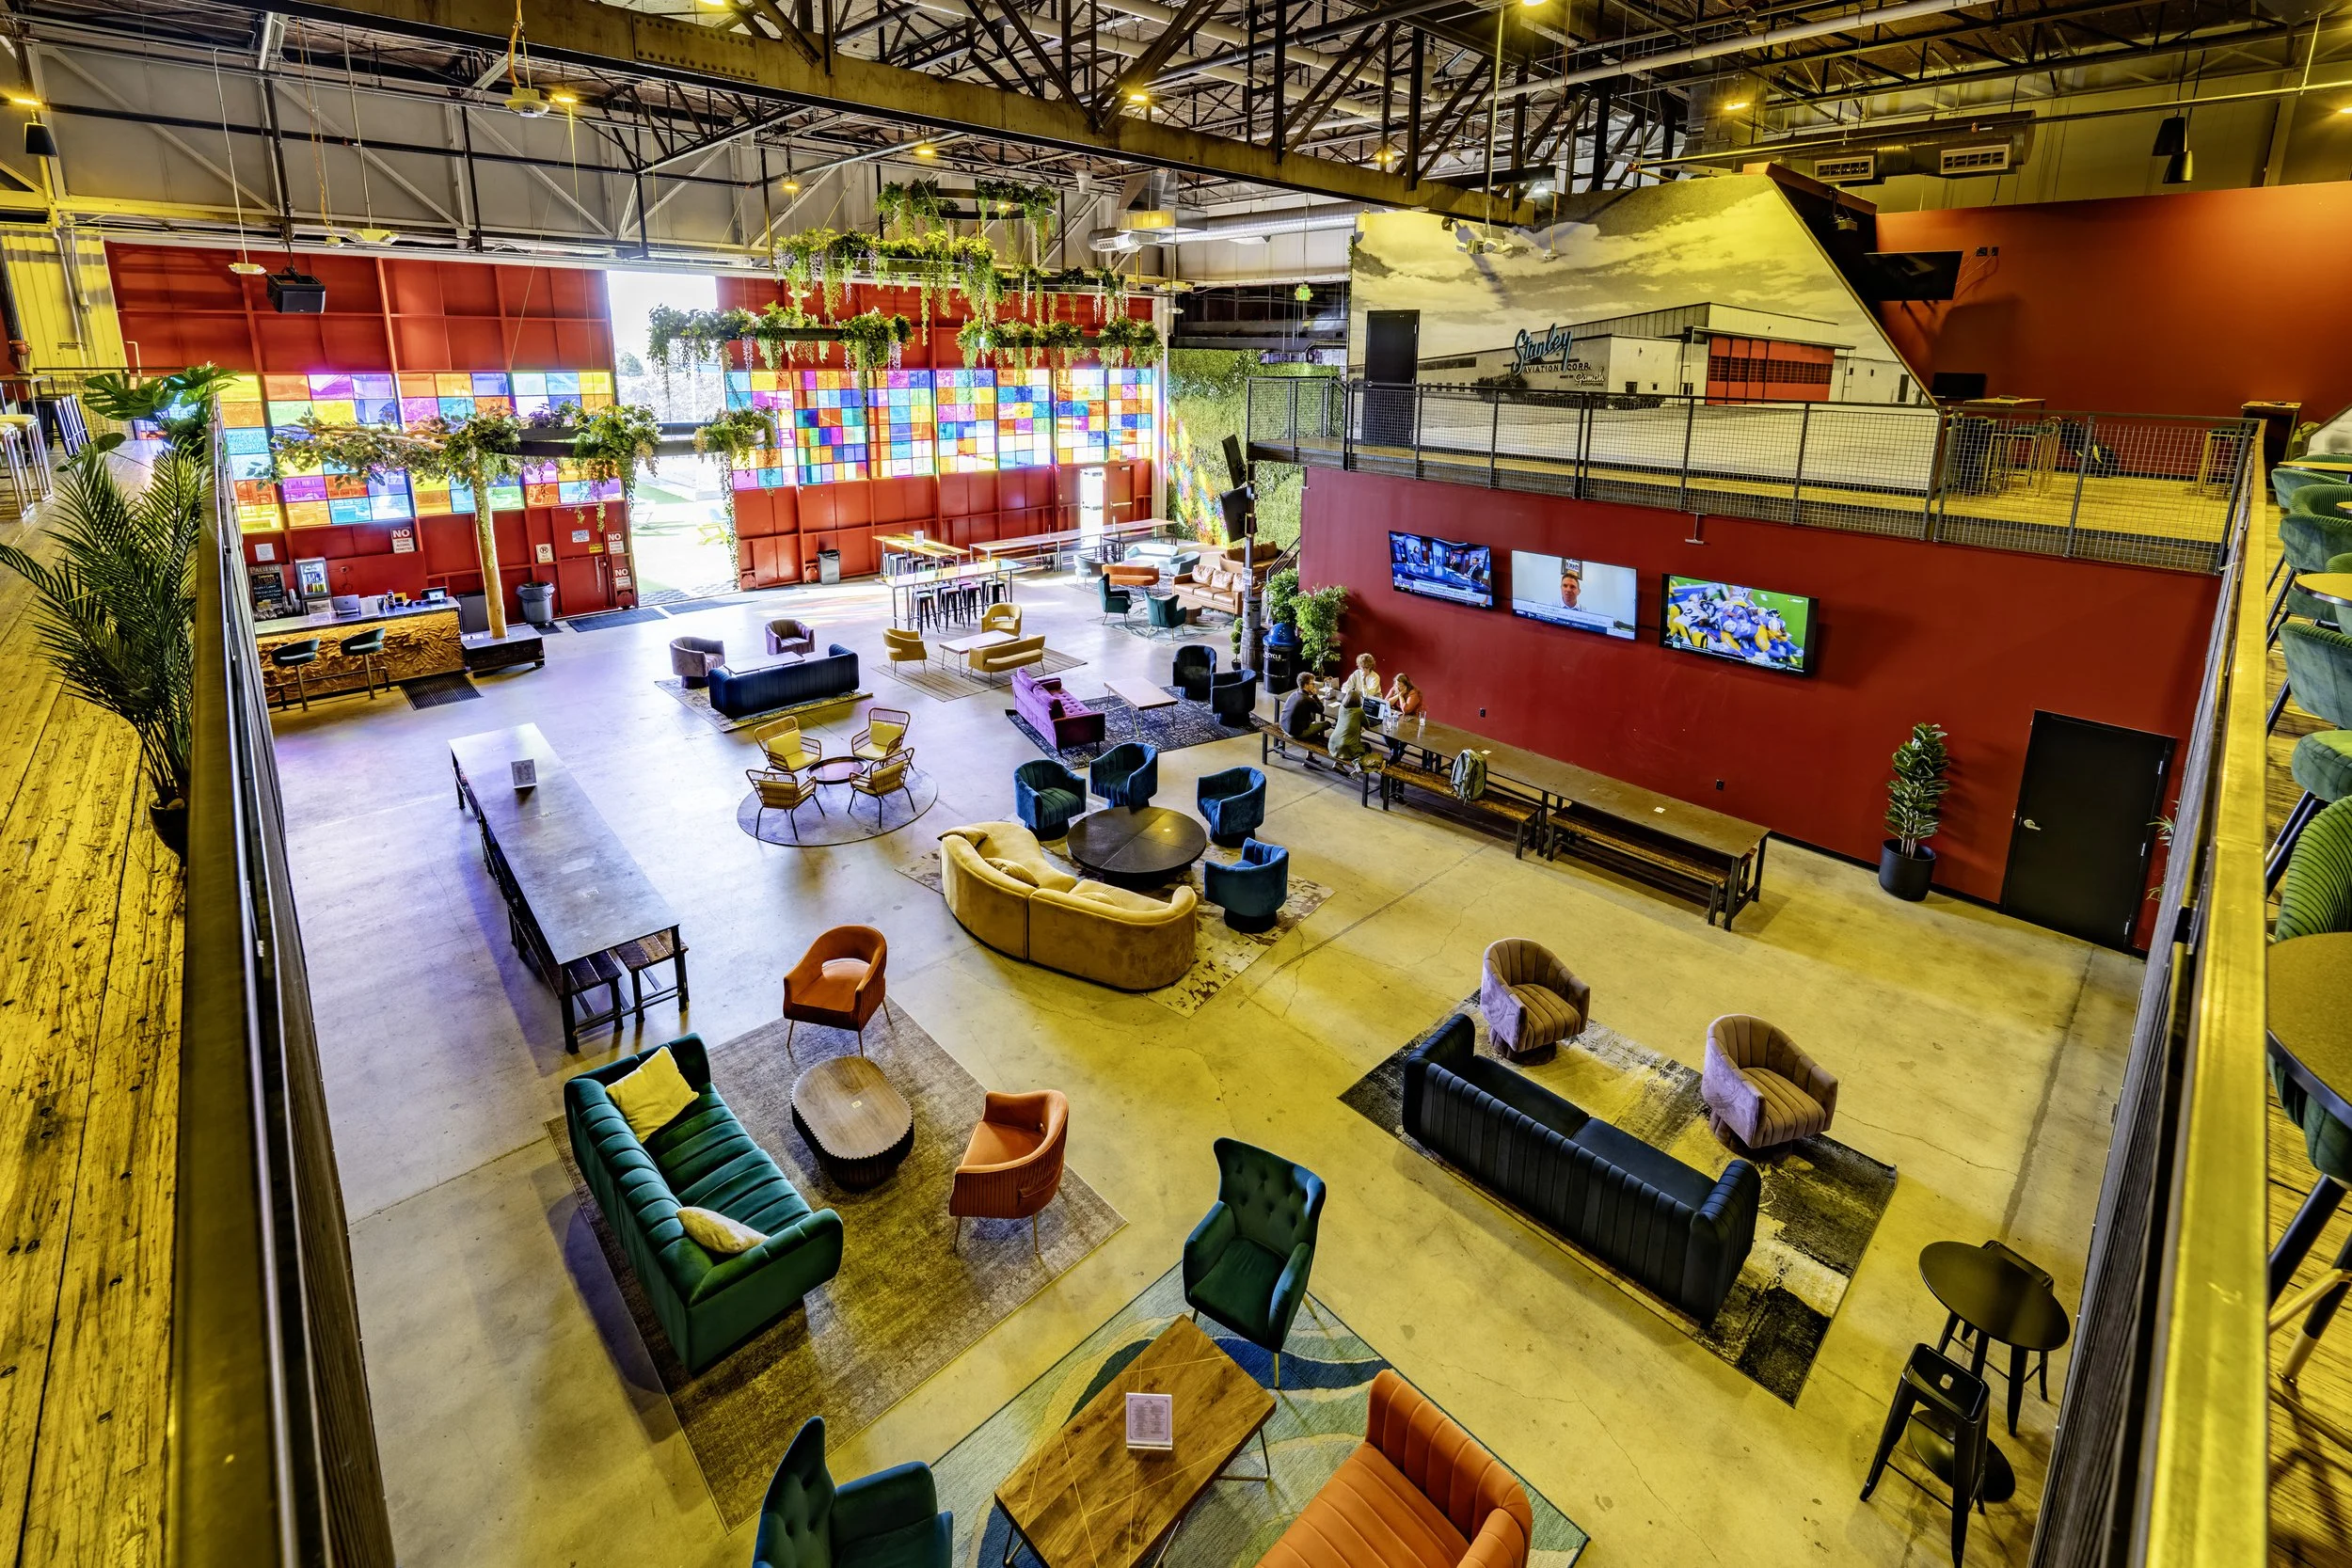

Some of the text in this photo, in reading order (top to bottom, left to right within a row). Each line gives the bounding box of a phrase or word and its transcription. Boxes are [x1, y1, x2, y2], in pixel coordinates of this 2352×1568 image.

[1511, 323, 1572, 375] Stanley
[1523, 364, 1559, 373] AVIATION
[392, 529, 410, 538] NO
[614, 568, 628, 577] NO
